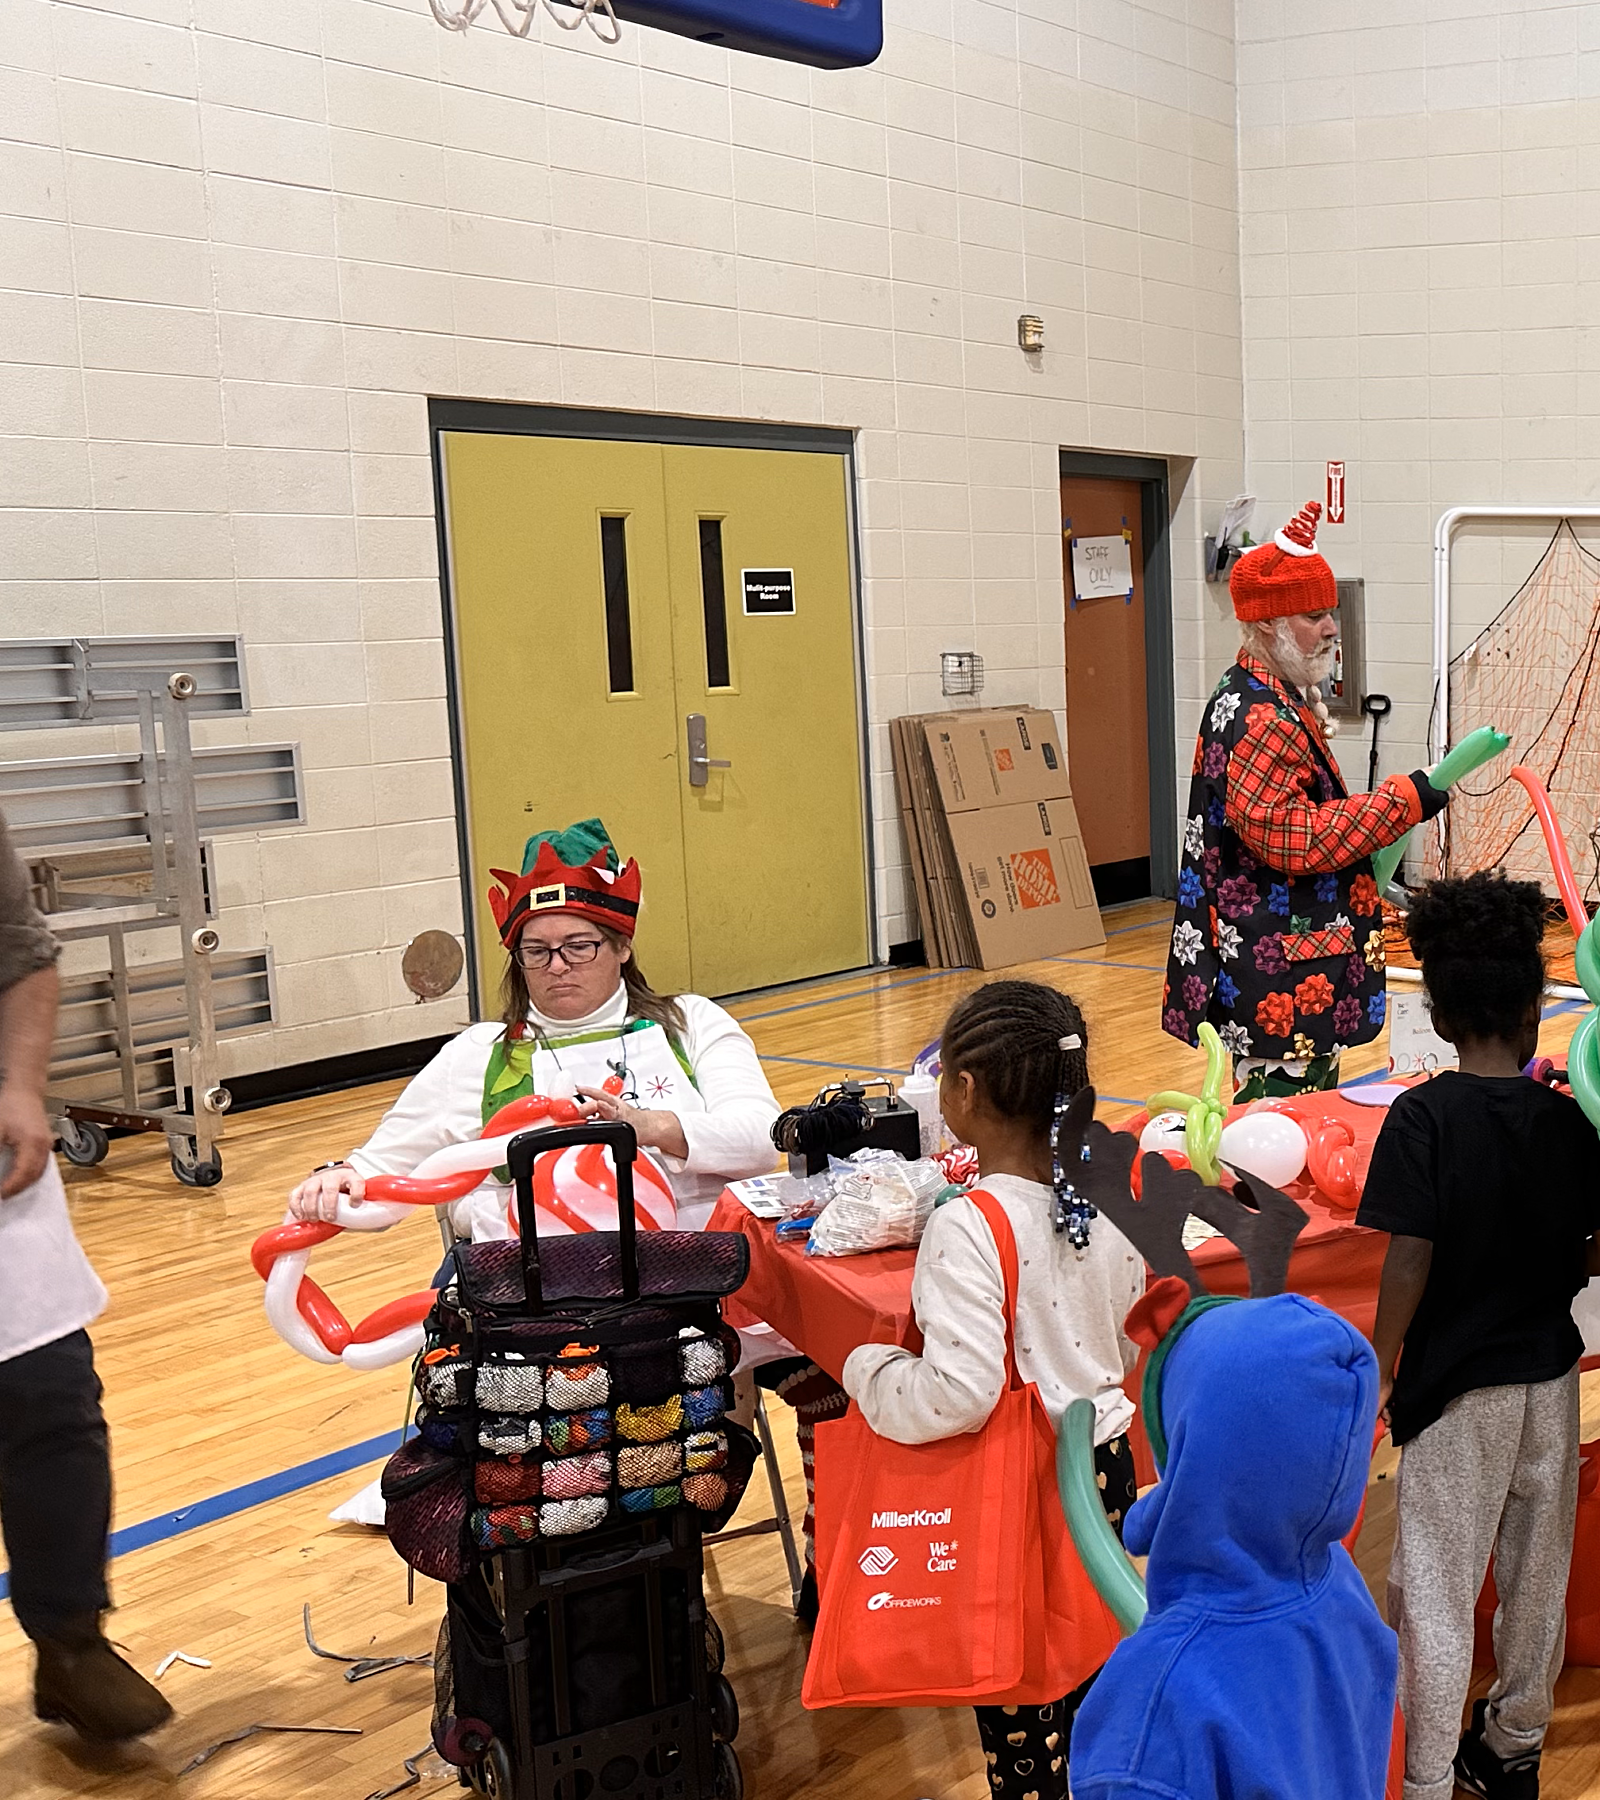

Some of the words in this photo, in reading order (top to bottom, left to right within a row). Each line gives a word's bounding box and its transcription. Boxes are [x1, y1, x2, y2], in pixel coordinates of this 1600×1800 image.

[1085, 546, 1109, 560] STAFF
[1089, 567, 1112, 584] ONLY
[760, 592, 779, 600] Room
[1017, 718, 1030, 748] LARGE
[1032, 855, 1051, 875] THE
[1012, 853, 1057, 902] HOME
[1016, 874, 1046, 906] DEPOT
[871, 1507, 952, 1529] MillerKnoll
[928, 1541, 950, 1557] We
[927, 1557, 957, 1573] Care
